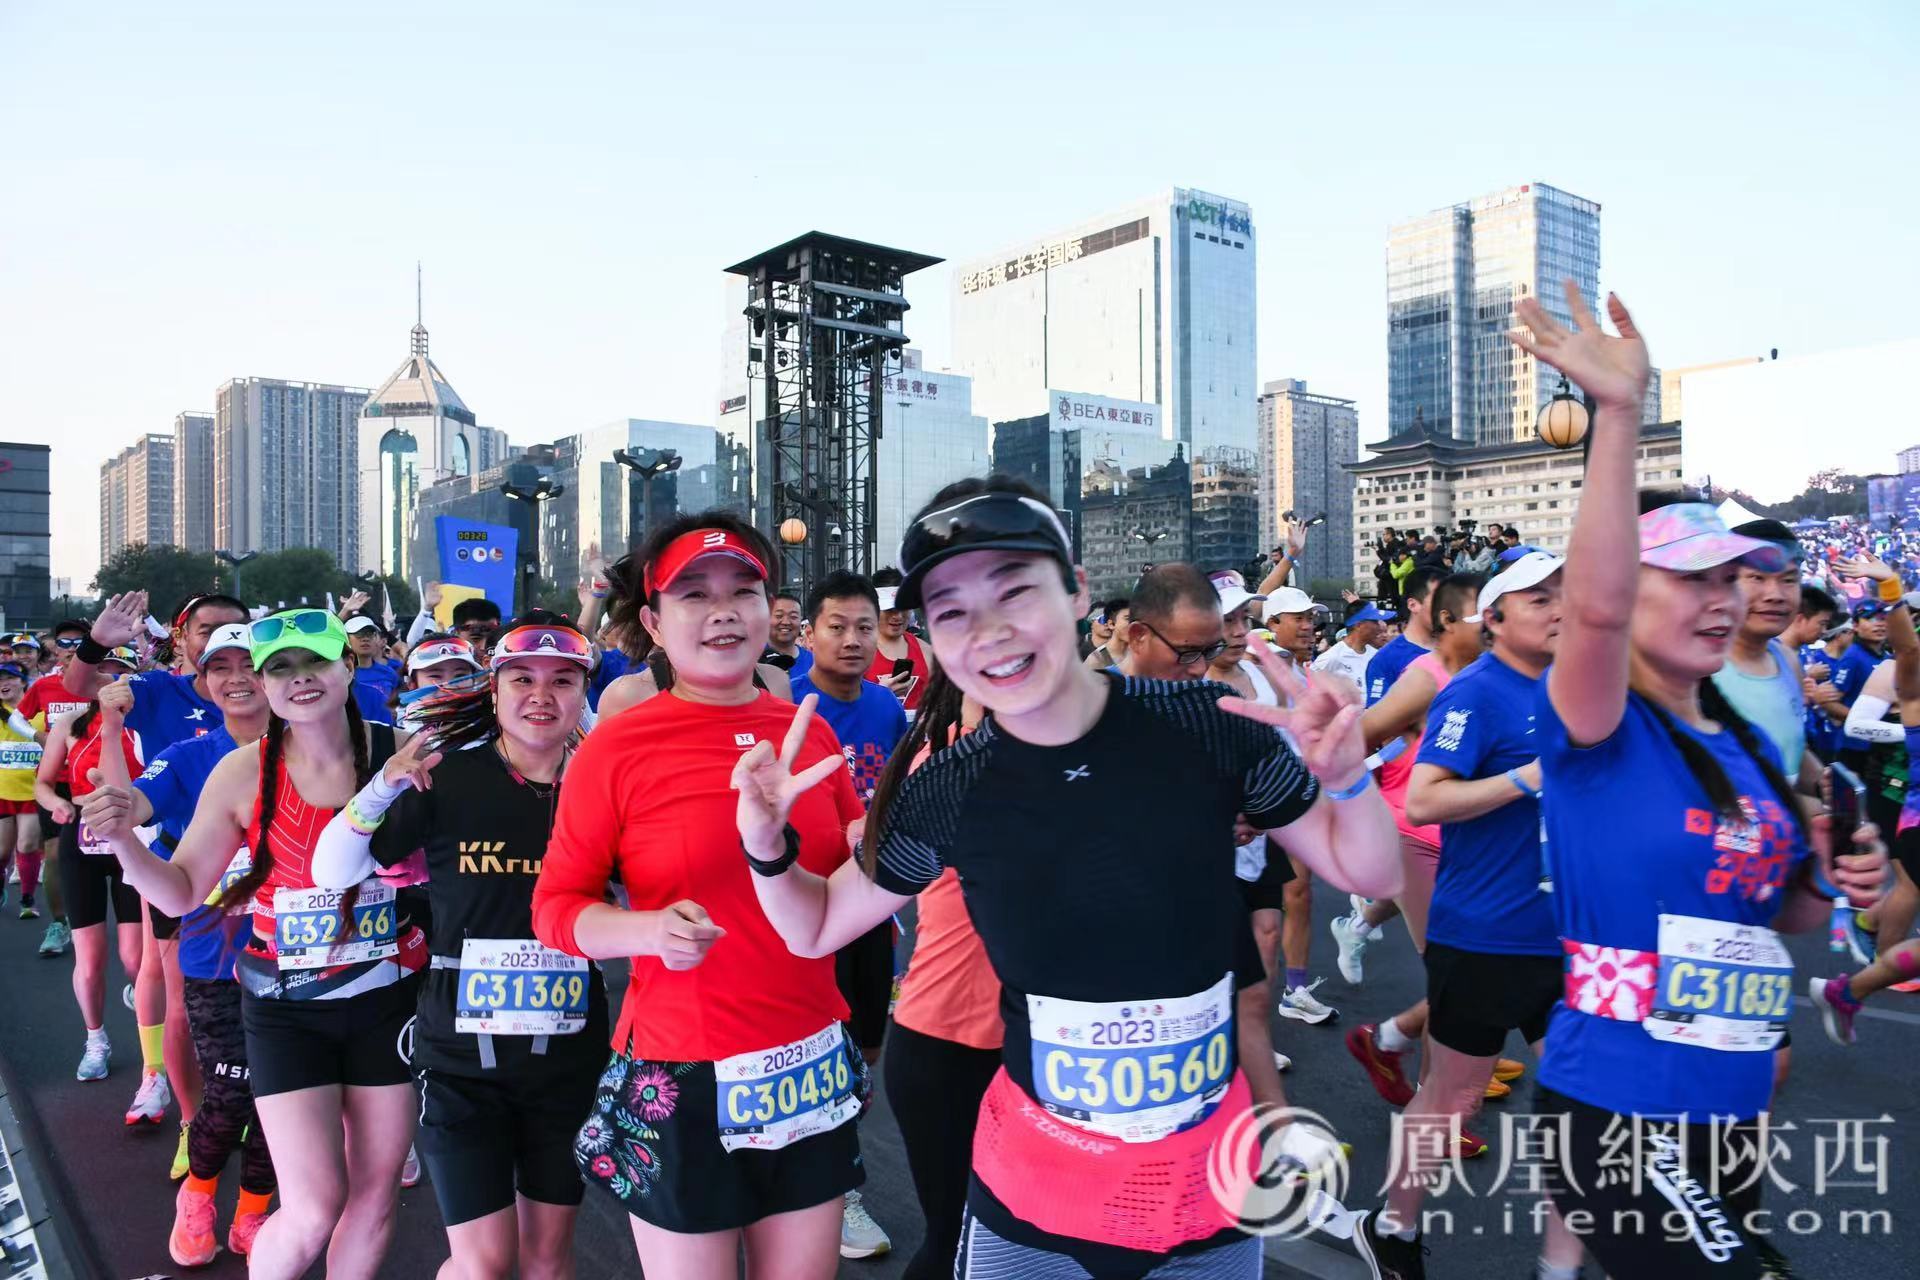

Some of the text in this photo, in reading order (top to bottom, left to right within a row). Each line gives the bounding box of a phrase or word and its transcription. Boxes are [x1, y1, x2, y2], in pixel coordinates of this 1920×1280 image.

[1073, 402, 1105, 420] BEA
[308, 893, 344, 909] 2023
[282, 907, 389, 946] C3266
[500, 952, 540, 968] 2023
[466, 972, 583, 1008] C31369
[1667, 962, 1792, 1017] C31832
[1091, 1020, 1155, 1045] 2023
[763, 1045, 803, 1073] 2023
[1045, 1032, 1227, 1107] C30560
[727, 1051, 848, 1123] C30436
